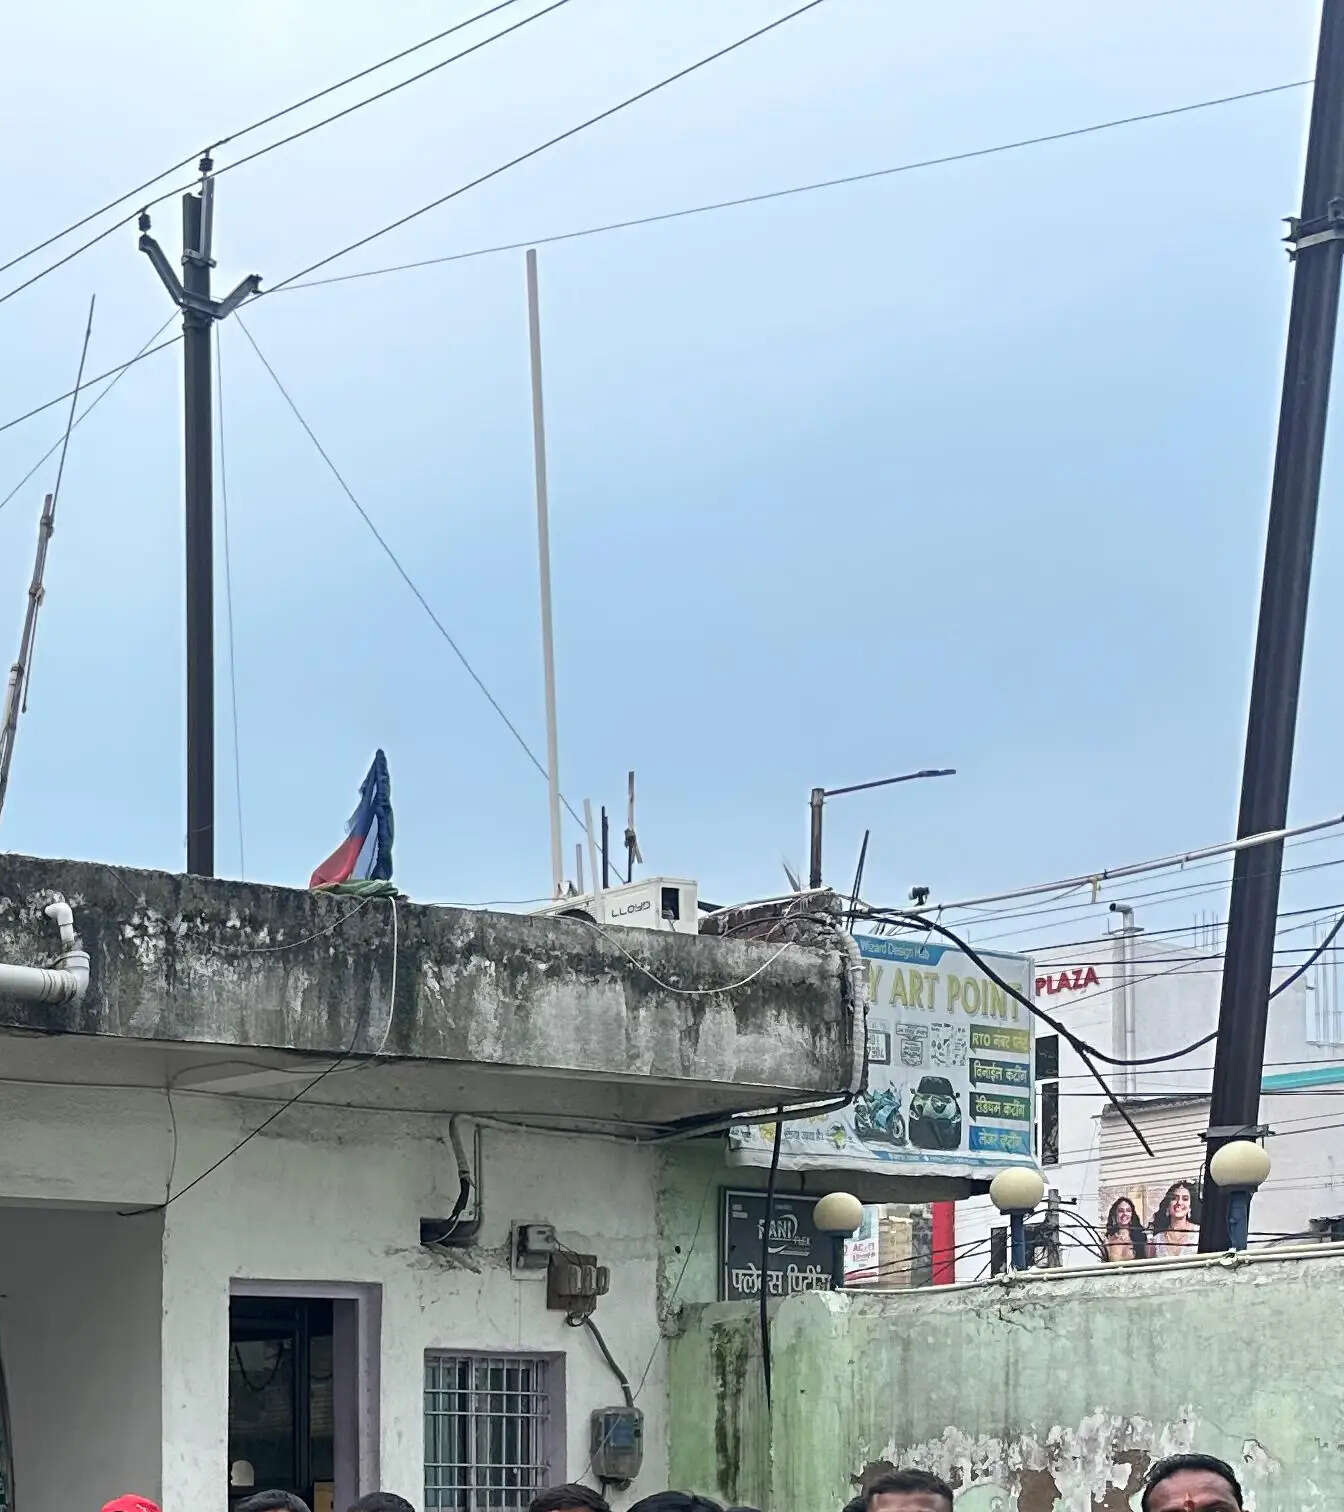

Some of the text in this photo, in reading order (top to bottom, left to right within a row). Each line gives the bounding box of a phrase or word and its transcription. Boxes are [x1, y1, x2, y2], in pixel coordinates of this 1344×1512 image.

[611, 901, 651, 918] LLOYD
[1035, 966, 1100, 997] PLAZA
[890, 967, 939, 1009] ART
[947, 974, 1023, 1021] POINT
[972, 1033, 990, 1046] RTO
